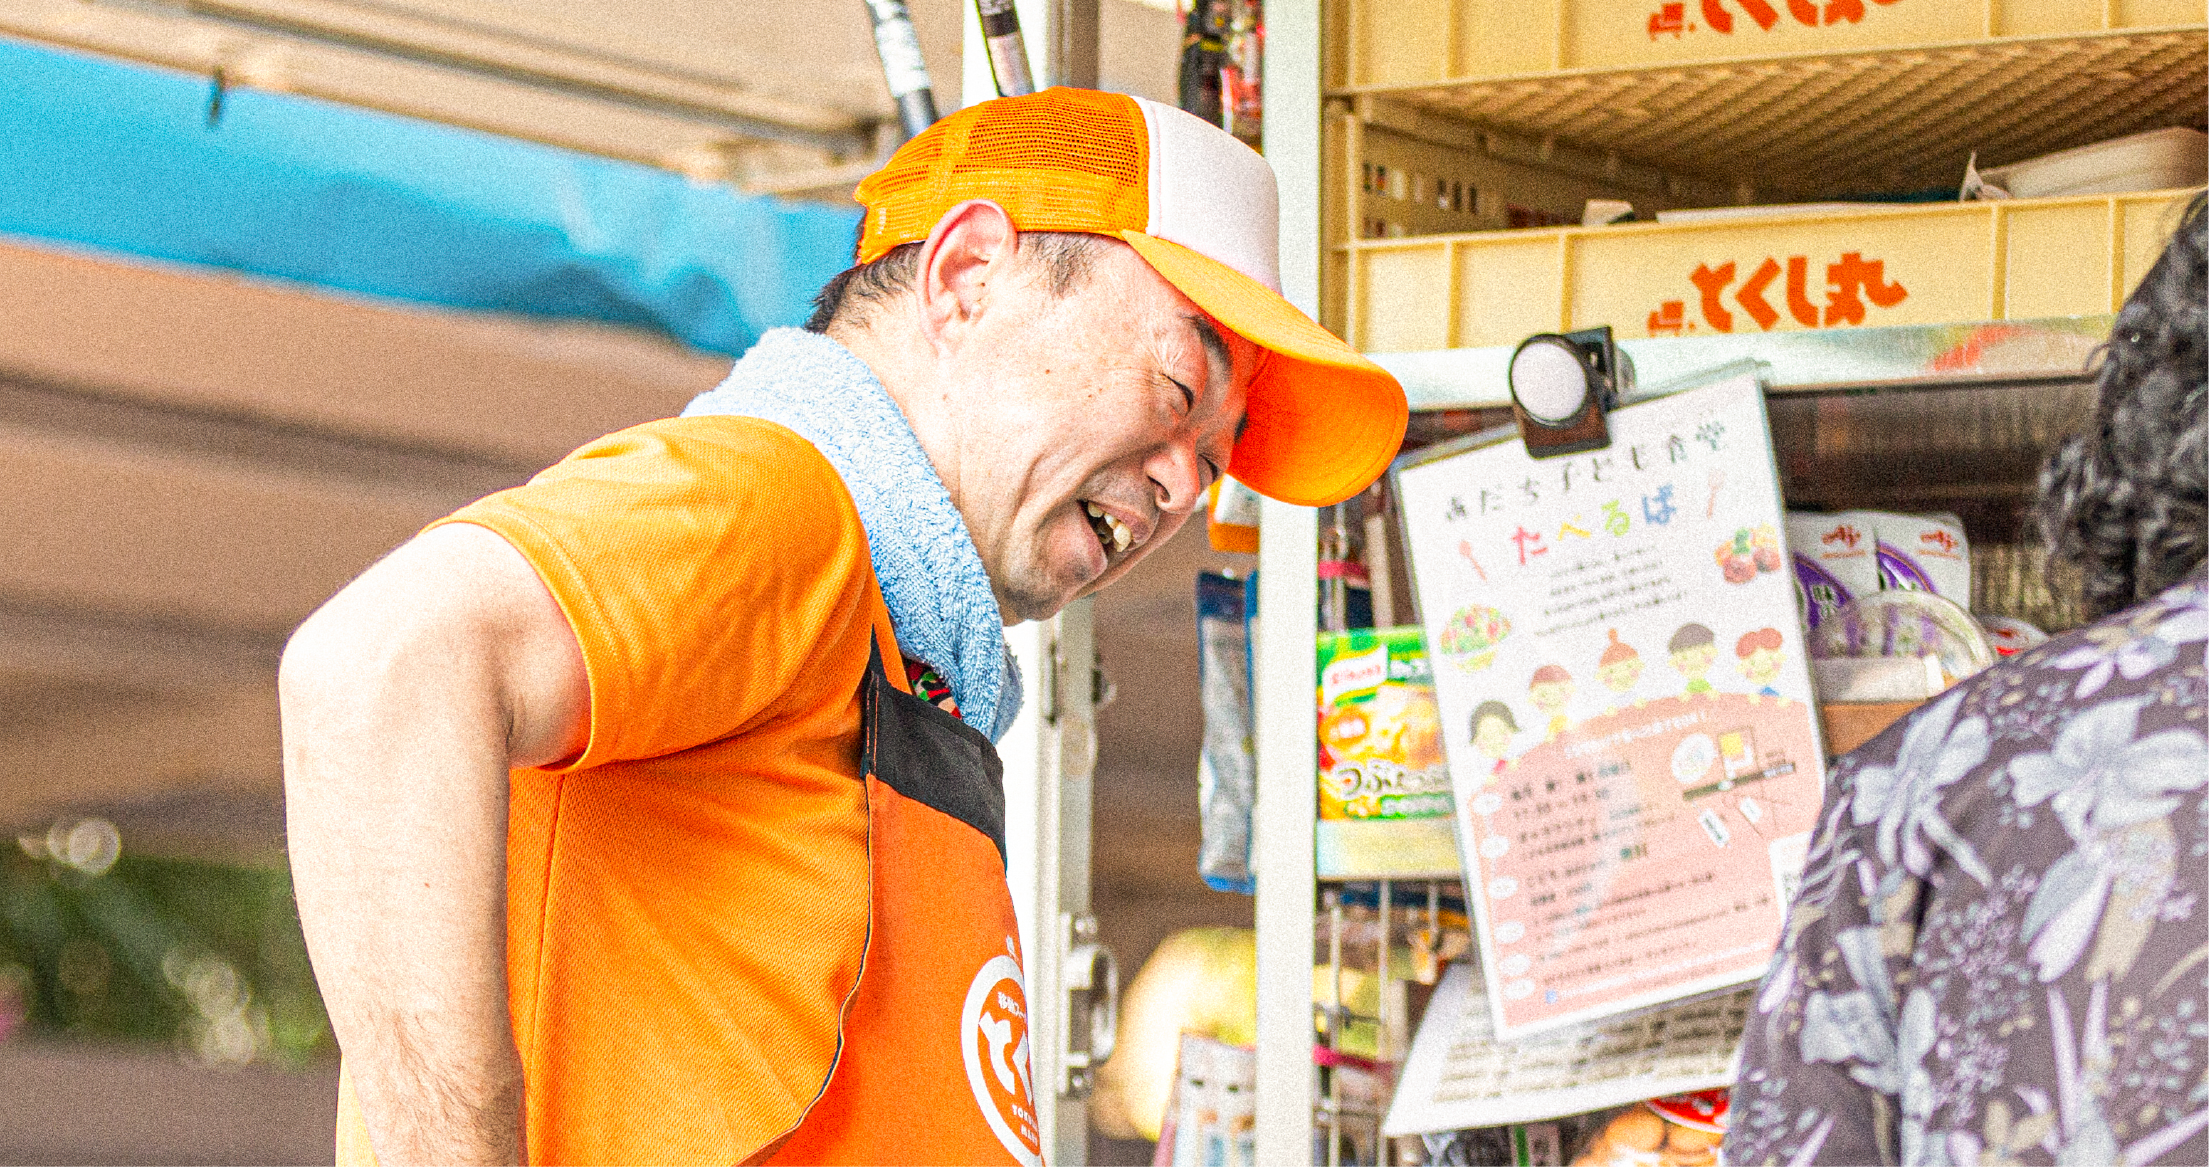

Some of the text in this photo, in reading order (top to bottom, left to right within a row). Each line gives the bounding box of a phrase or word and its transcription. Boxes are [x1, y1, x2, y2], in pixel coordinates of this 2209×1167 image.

[1689, 251, 1909, 334] とくし丸
[1511, 483, 1678, 567] たべるば
